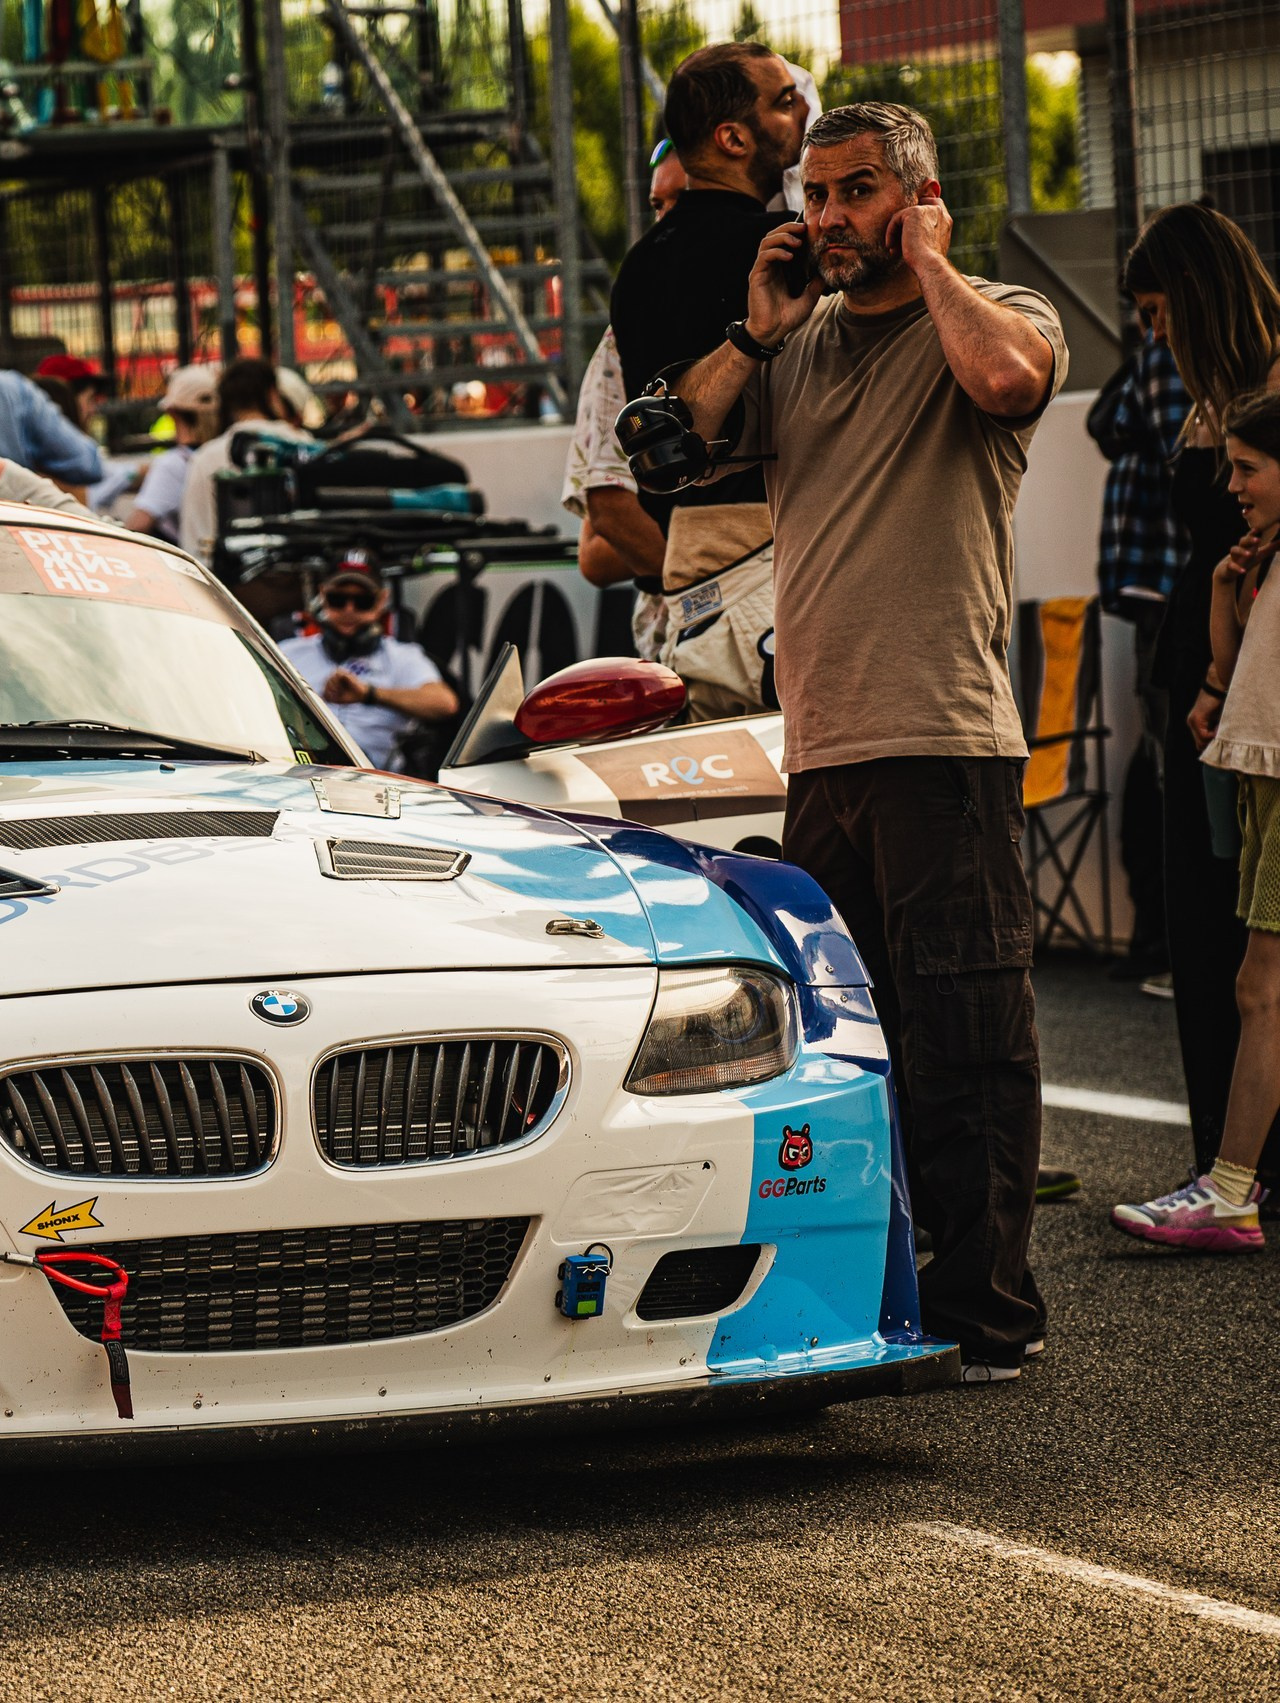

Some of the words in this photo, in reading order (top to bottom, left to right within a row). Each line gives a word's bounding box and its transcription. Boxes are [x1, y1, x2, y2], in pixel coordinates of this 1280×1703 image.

[19, 530, 97, 554] РГС
[35, 551, 137, 578] ЖИЗ
[45, 568, 110, 593] НЬ
[255, 990, 299, 1002] BMW
[758, 1176, 827, 1199] GGParts
[37, 1213, 81, 1230] SHONX
